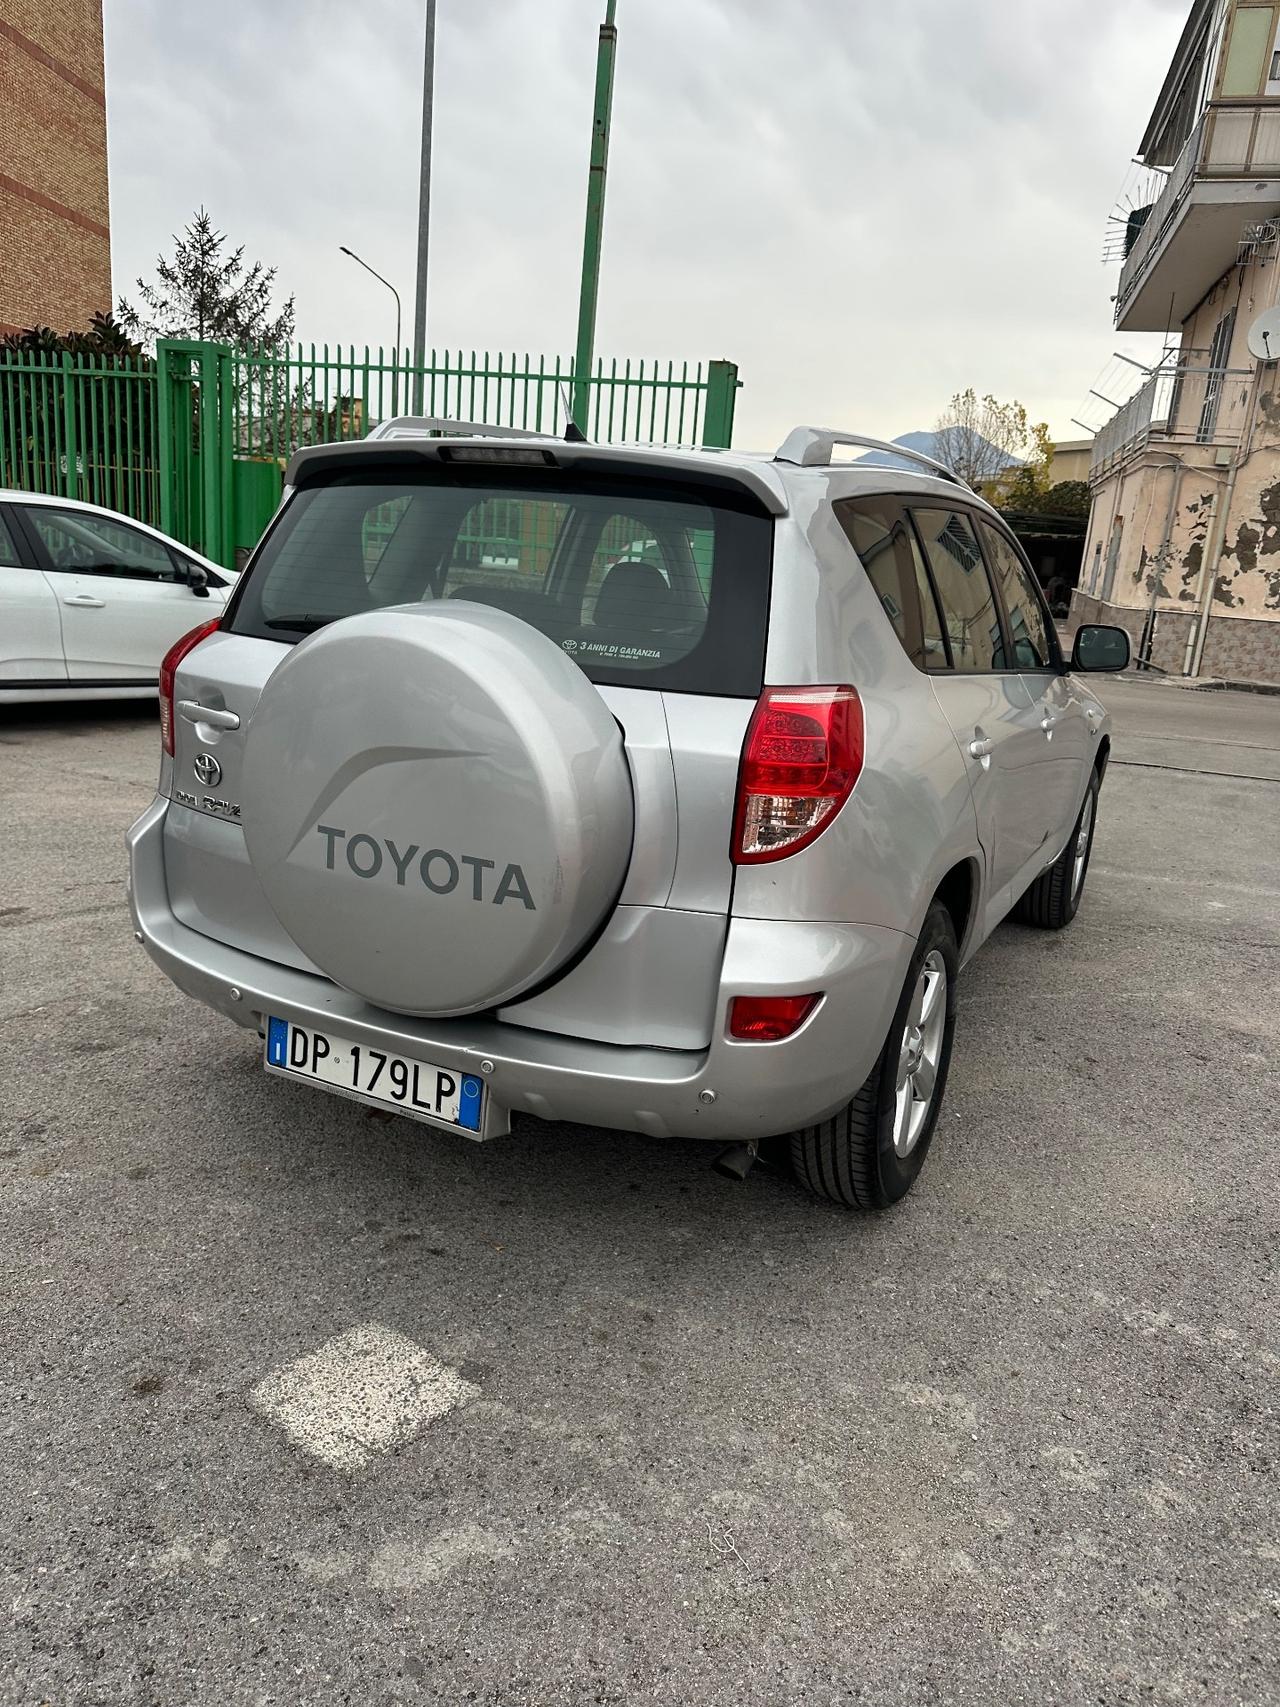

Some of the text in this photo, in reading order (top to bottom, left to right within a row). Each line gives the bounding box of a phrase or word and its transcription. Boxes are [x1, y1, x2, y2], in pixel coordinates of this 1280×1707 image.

[580, 641, 587, 650] 3
[587, 643, 607, 653] ANNI
[609, 645, 619, 653] DI
[620, 646, 661, 659] GARANZIA
[317, 824, 537, 911] TOYOTA
[290, 1026, 331, 1074] DP
[350, 1045, 456, 1114] 179LP
